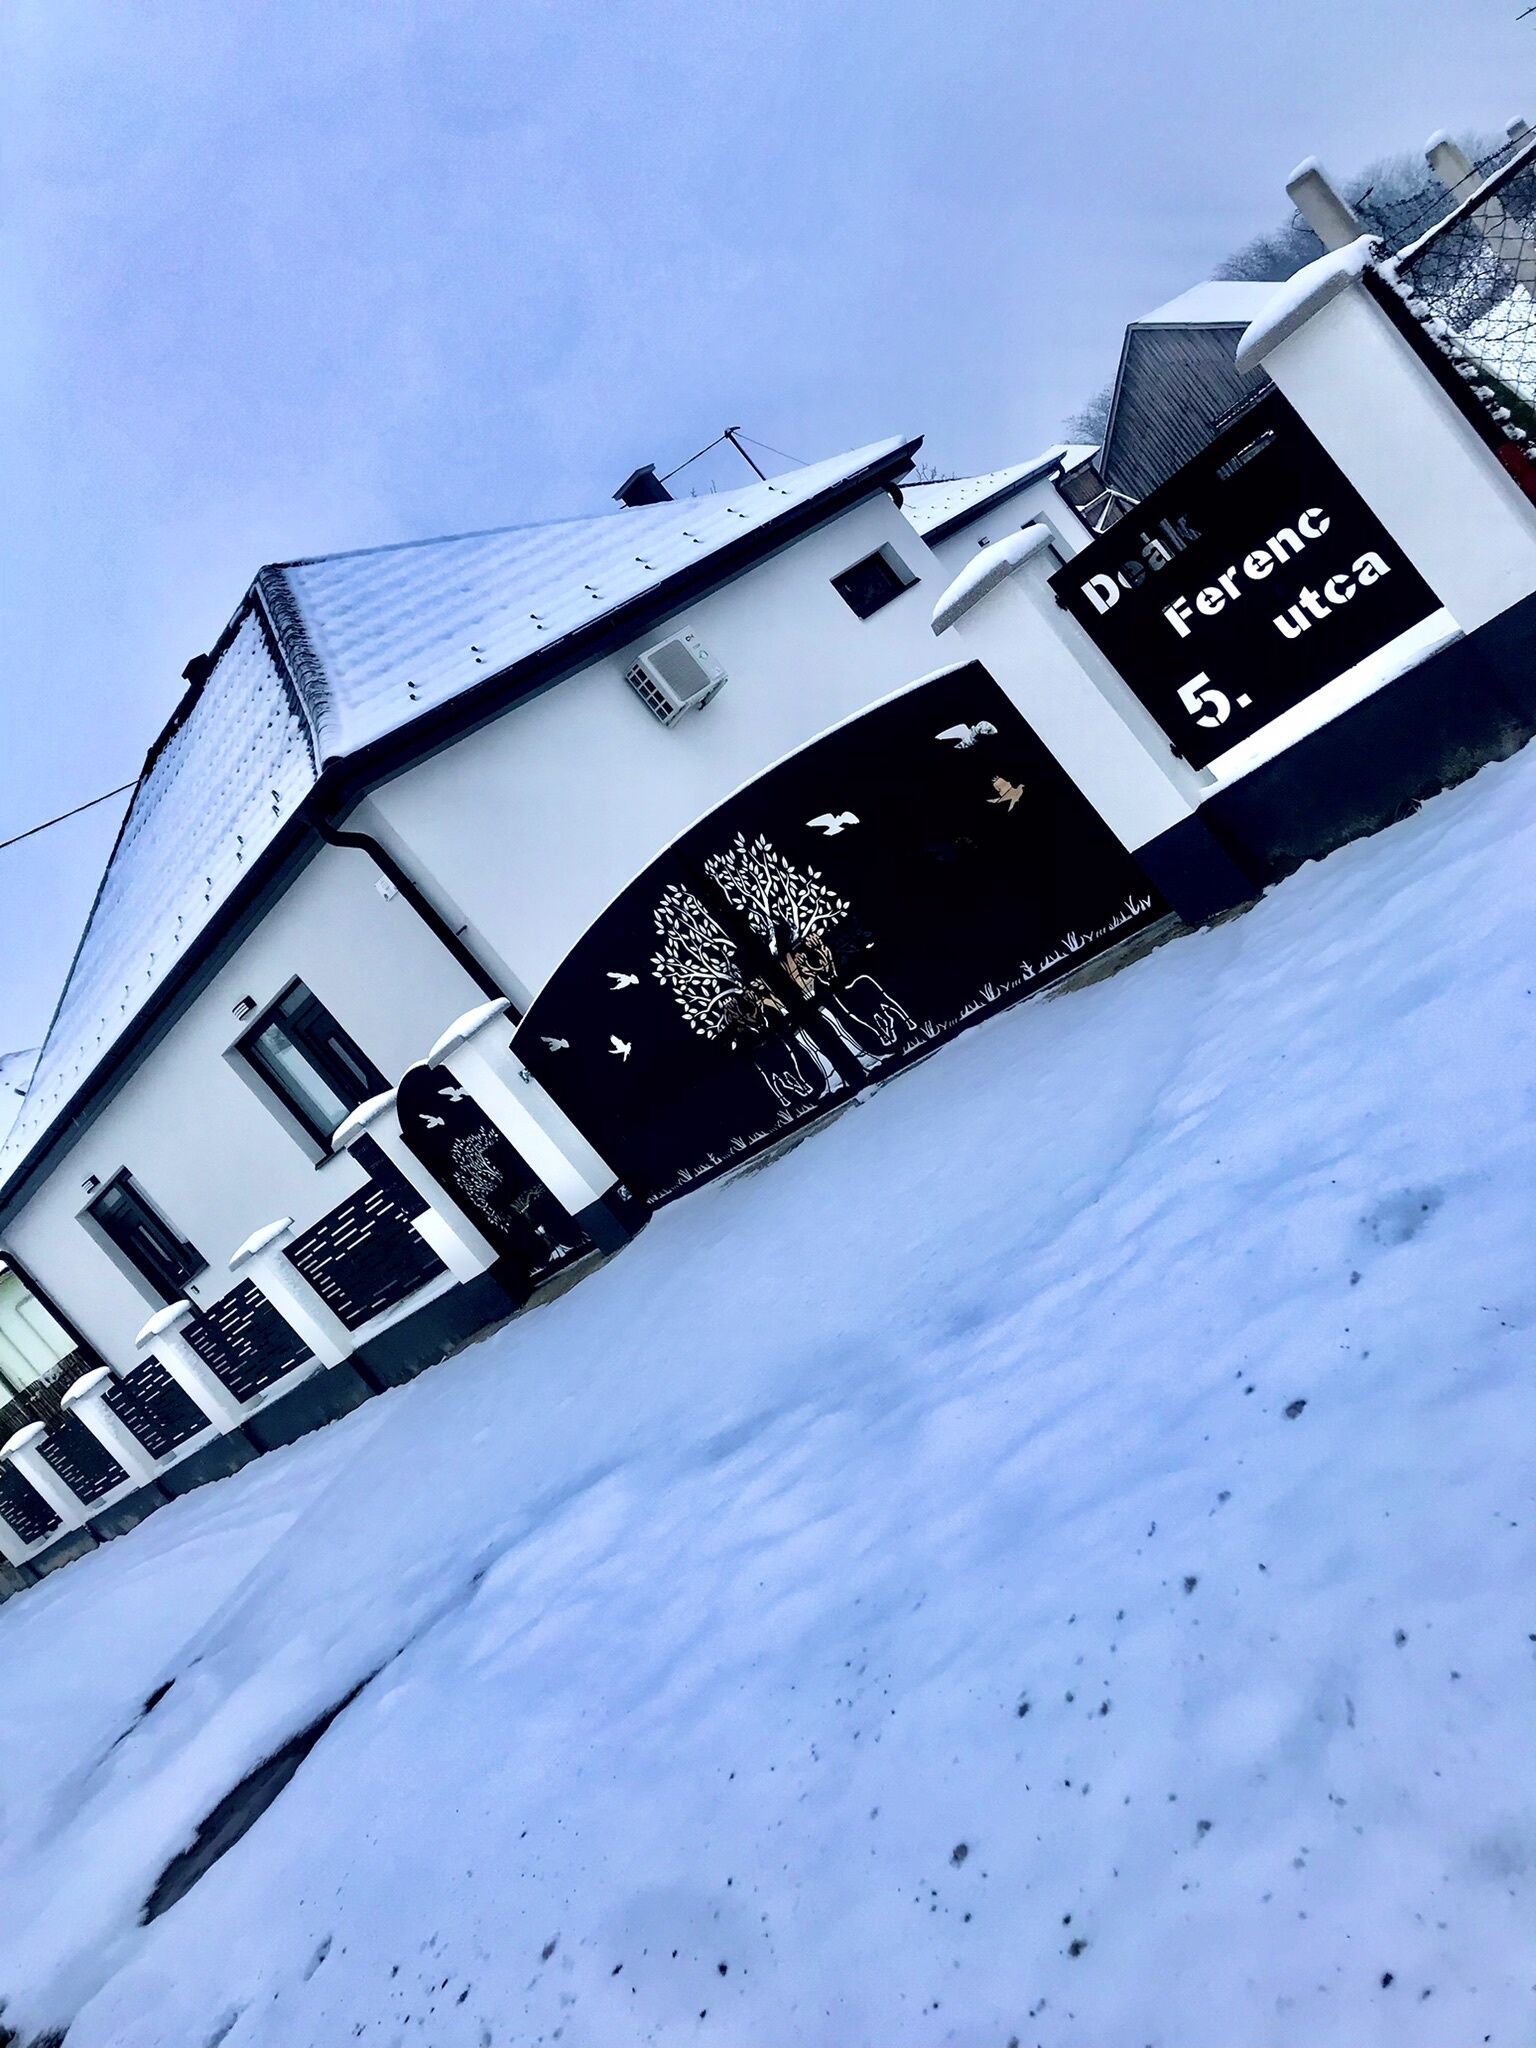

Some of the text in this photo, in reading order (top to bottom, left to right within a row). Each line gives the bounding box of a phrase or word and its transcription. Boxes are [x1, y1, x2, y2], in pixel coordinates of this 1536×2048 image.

[1162, 507, 1331, 638] Ferenc
[1272, 551, 1392, 639] utca
[1176, 671, 1253, 728] 5.
